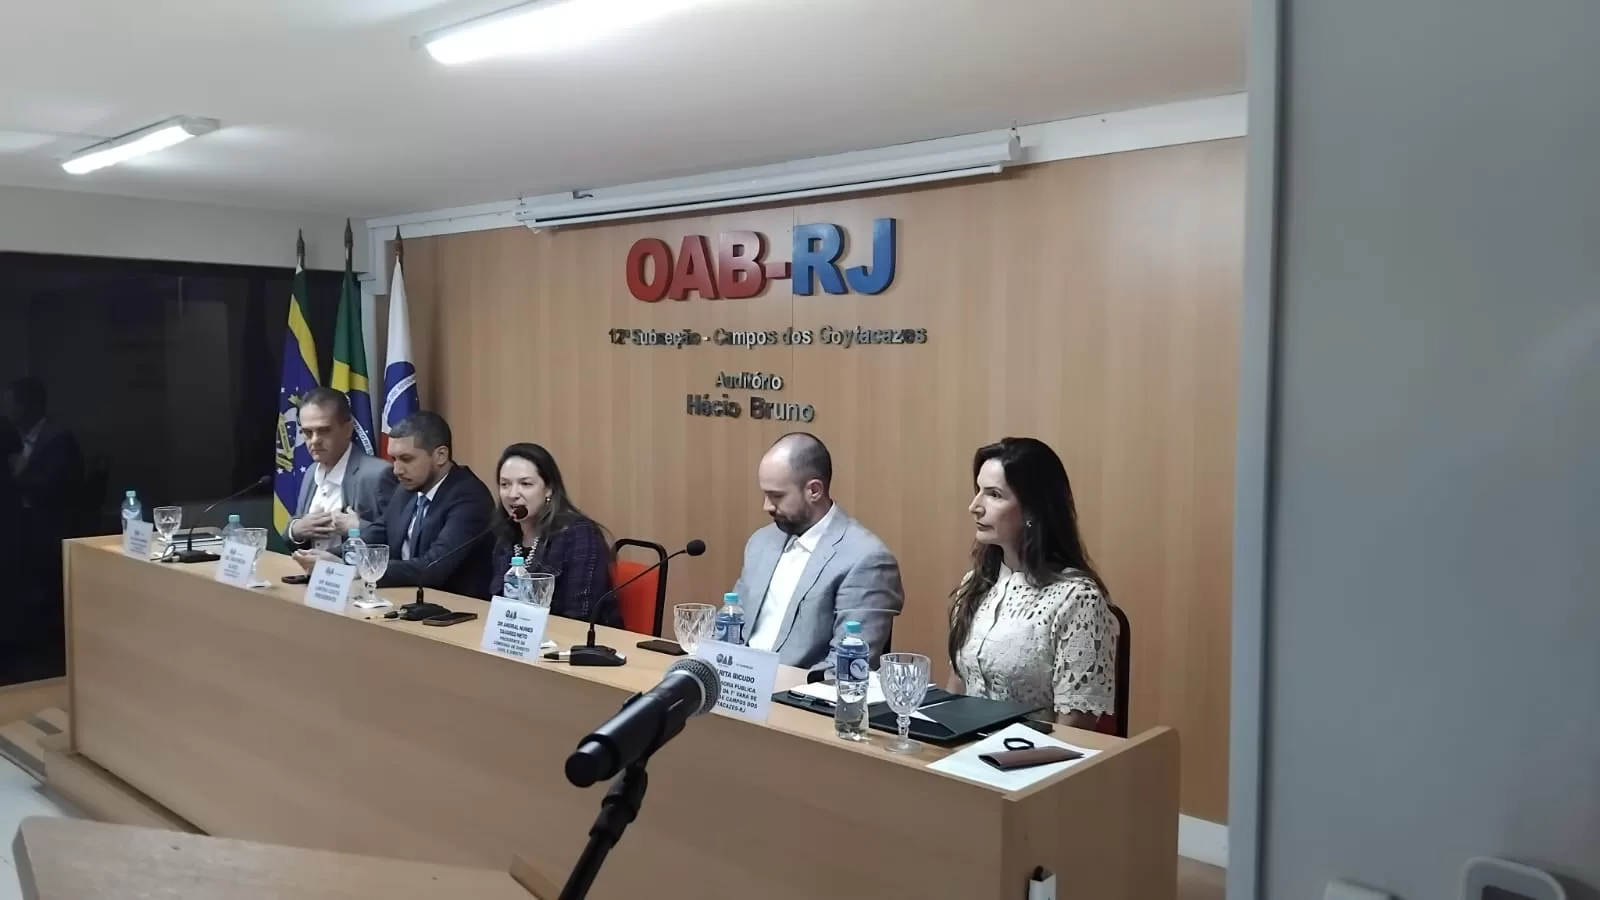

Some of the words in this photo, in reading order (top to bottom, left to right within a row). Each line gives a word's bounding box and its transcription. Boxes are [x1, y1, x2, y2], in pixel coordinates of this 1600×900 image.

[626, 217, 897, 302] OAB-RJ
[631, 328, 702, 349] Subseção
[713, 327, 779, 349] Campos
[782, 326, 813, 346] dos
[820, 324, 928, 349] Goytacazes
[715, 370, 784, 391] Auditório
[750, 396, 815, 423] Bruno
[716, 653, 733, 666] OAB
[733, 672, 755, 684] BICUDO
